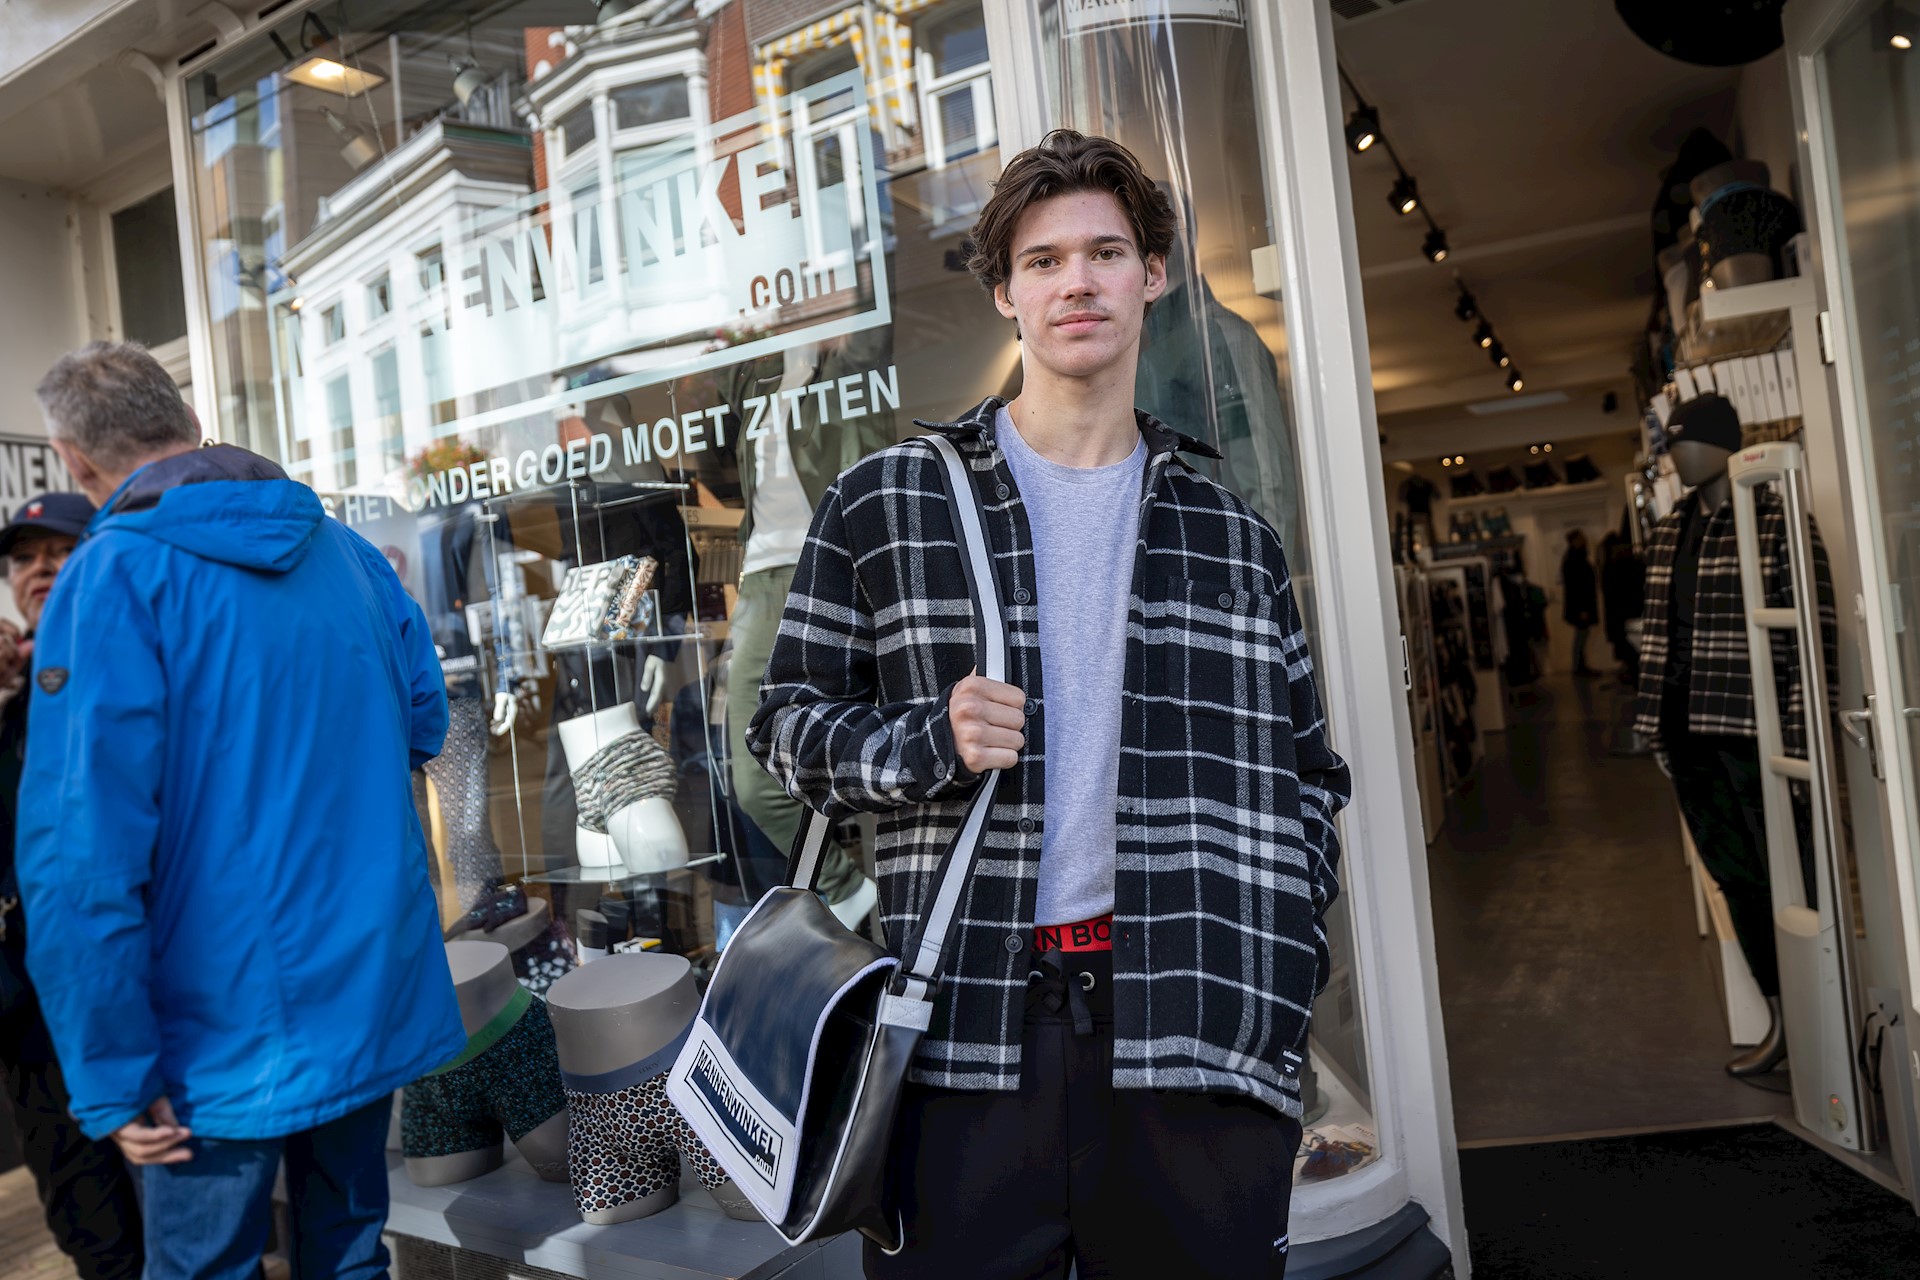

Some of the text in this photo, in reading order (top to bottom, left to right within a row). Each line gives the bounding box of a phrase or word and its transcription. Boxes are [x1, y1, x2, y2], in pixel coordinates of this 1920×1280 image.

[408, 433, 612, 512] ONDERGOED
[621, 404, 730, 467] MOET
[743, 365, 900, 442] ZITTEN
[698, 1049, 775, 1157] MANNENWINKEL
[754, 1153, 774, 1178] .com
